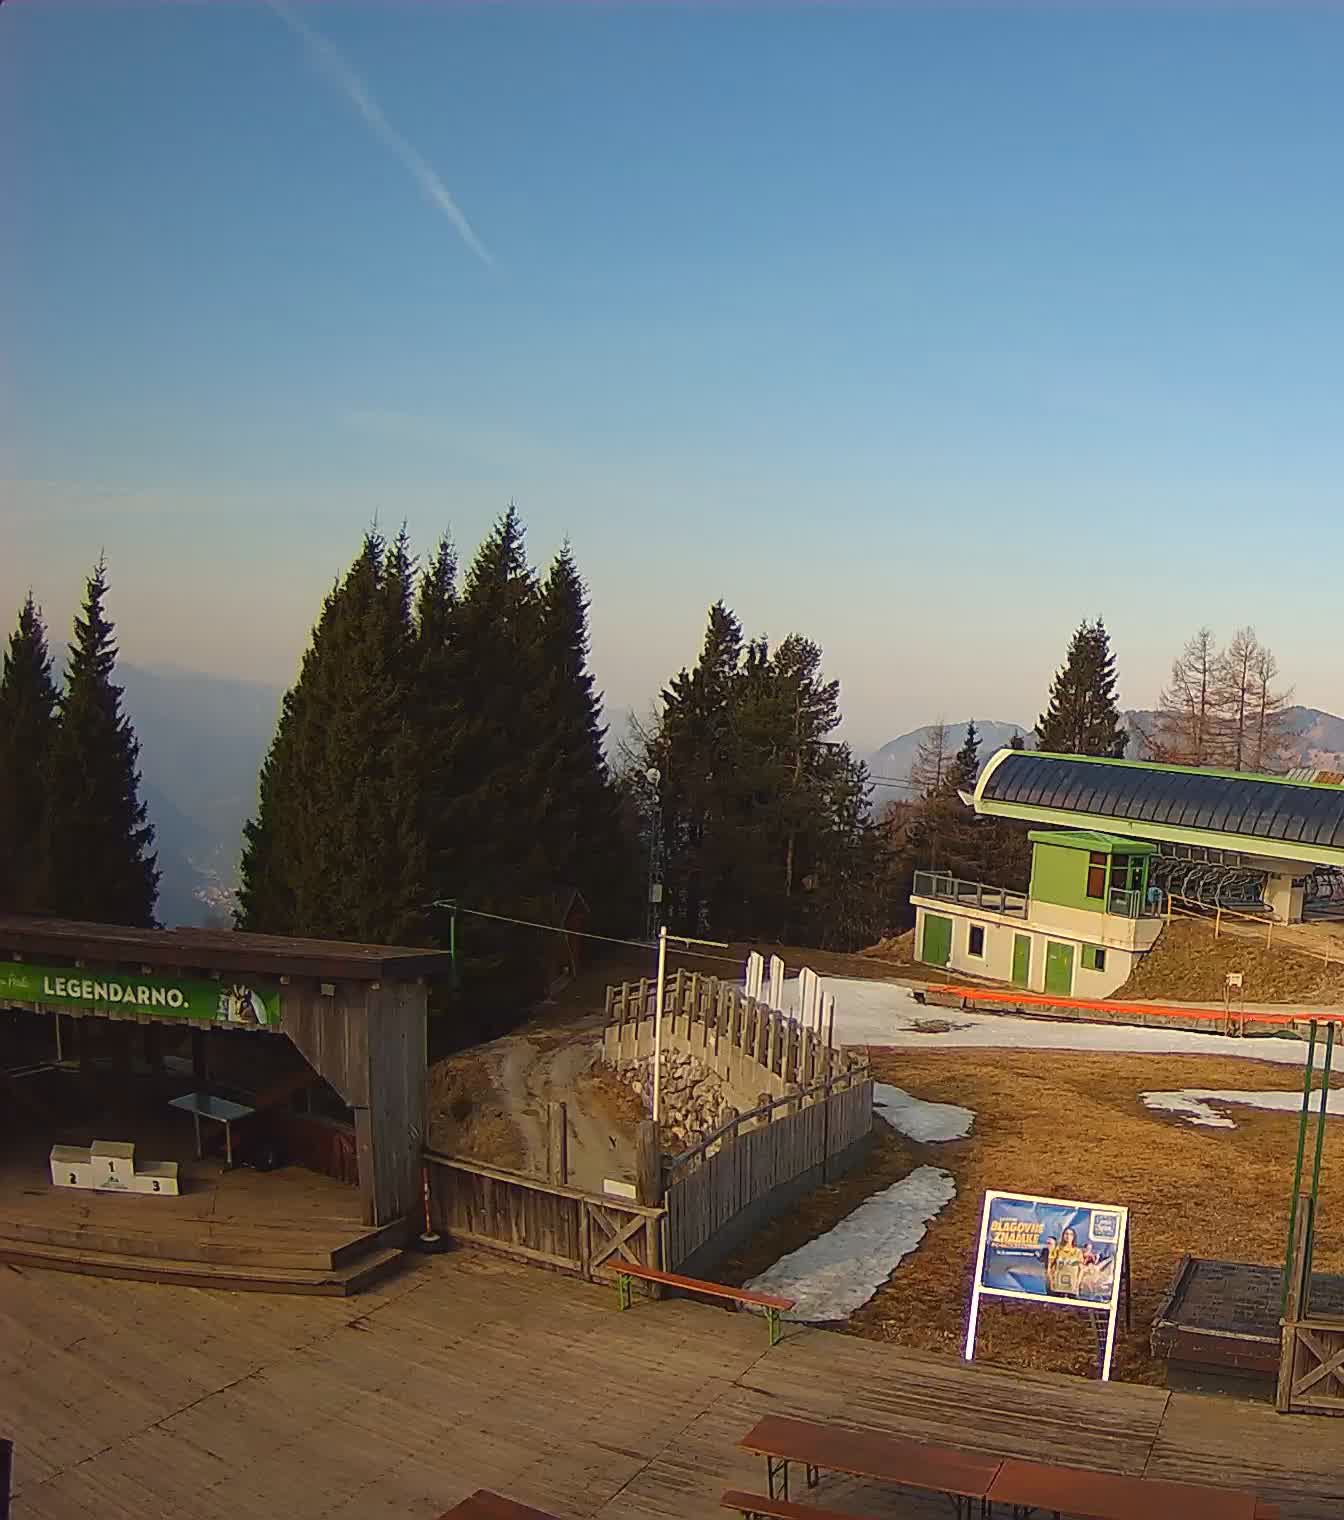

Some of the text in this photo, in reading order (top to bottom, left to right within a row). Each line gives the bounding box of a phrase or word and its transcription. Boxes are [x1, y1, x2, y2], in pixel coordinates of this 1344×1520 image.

[43, 976, 190, 1009] LEGENDARNO.
[108, 1160, 115, 1172] 1
[69, 1172, 77, 1184] 2
[152, 1181, 161, 1192] 3
